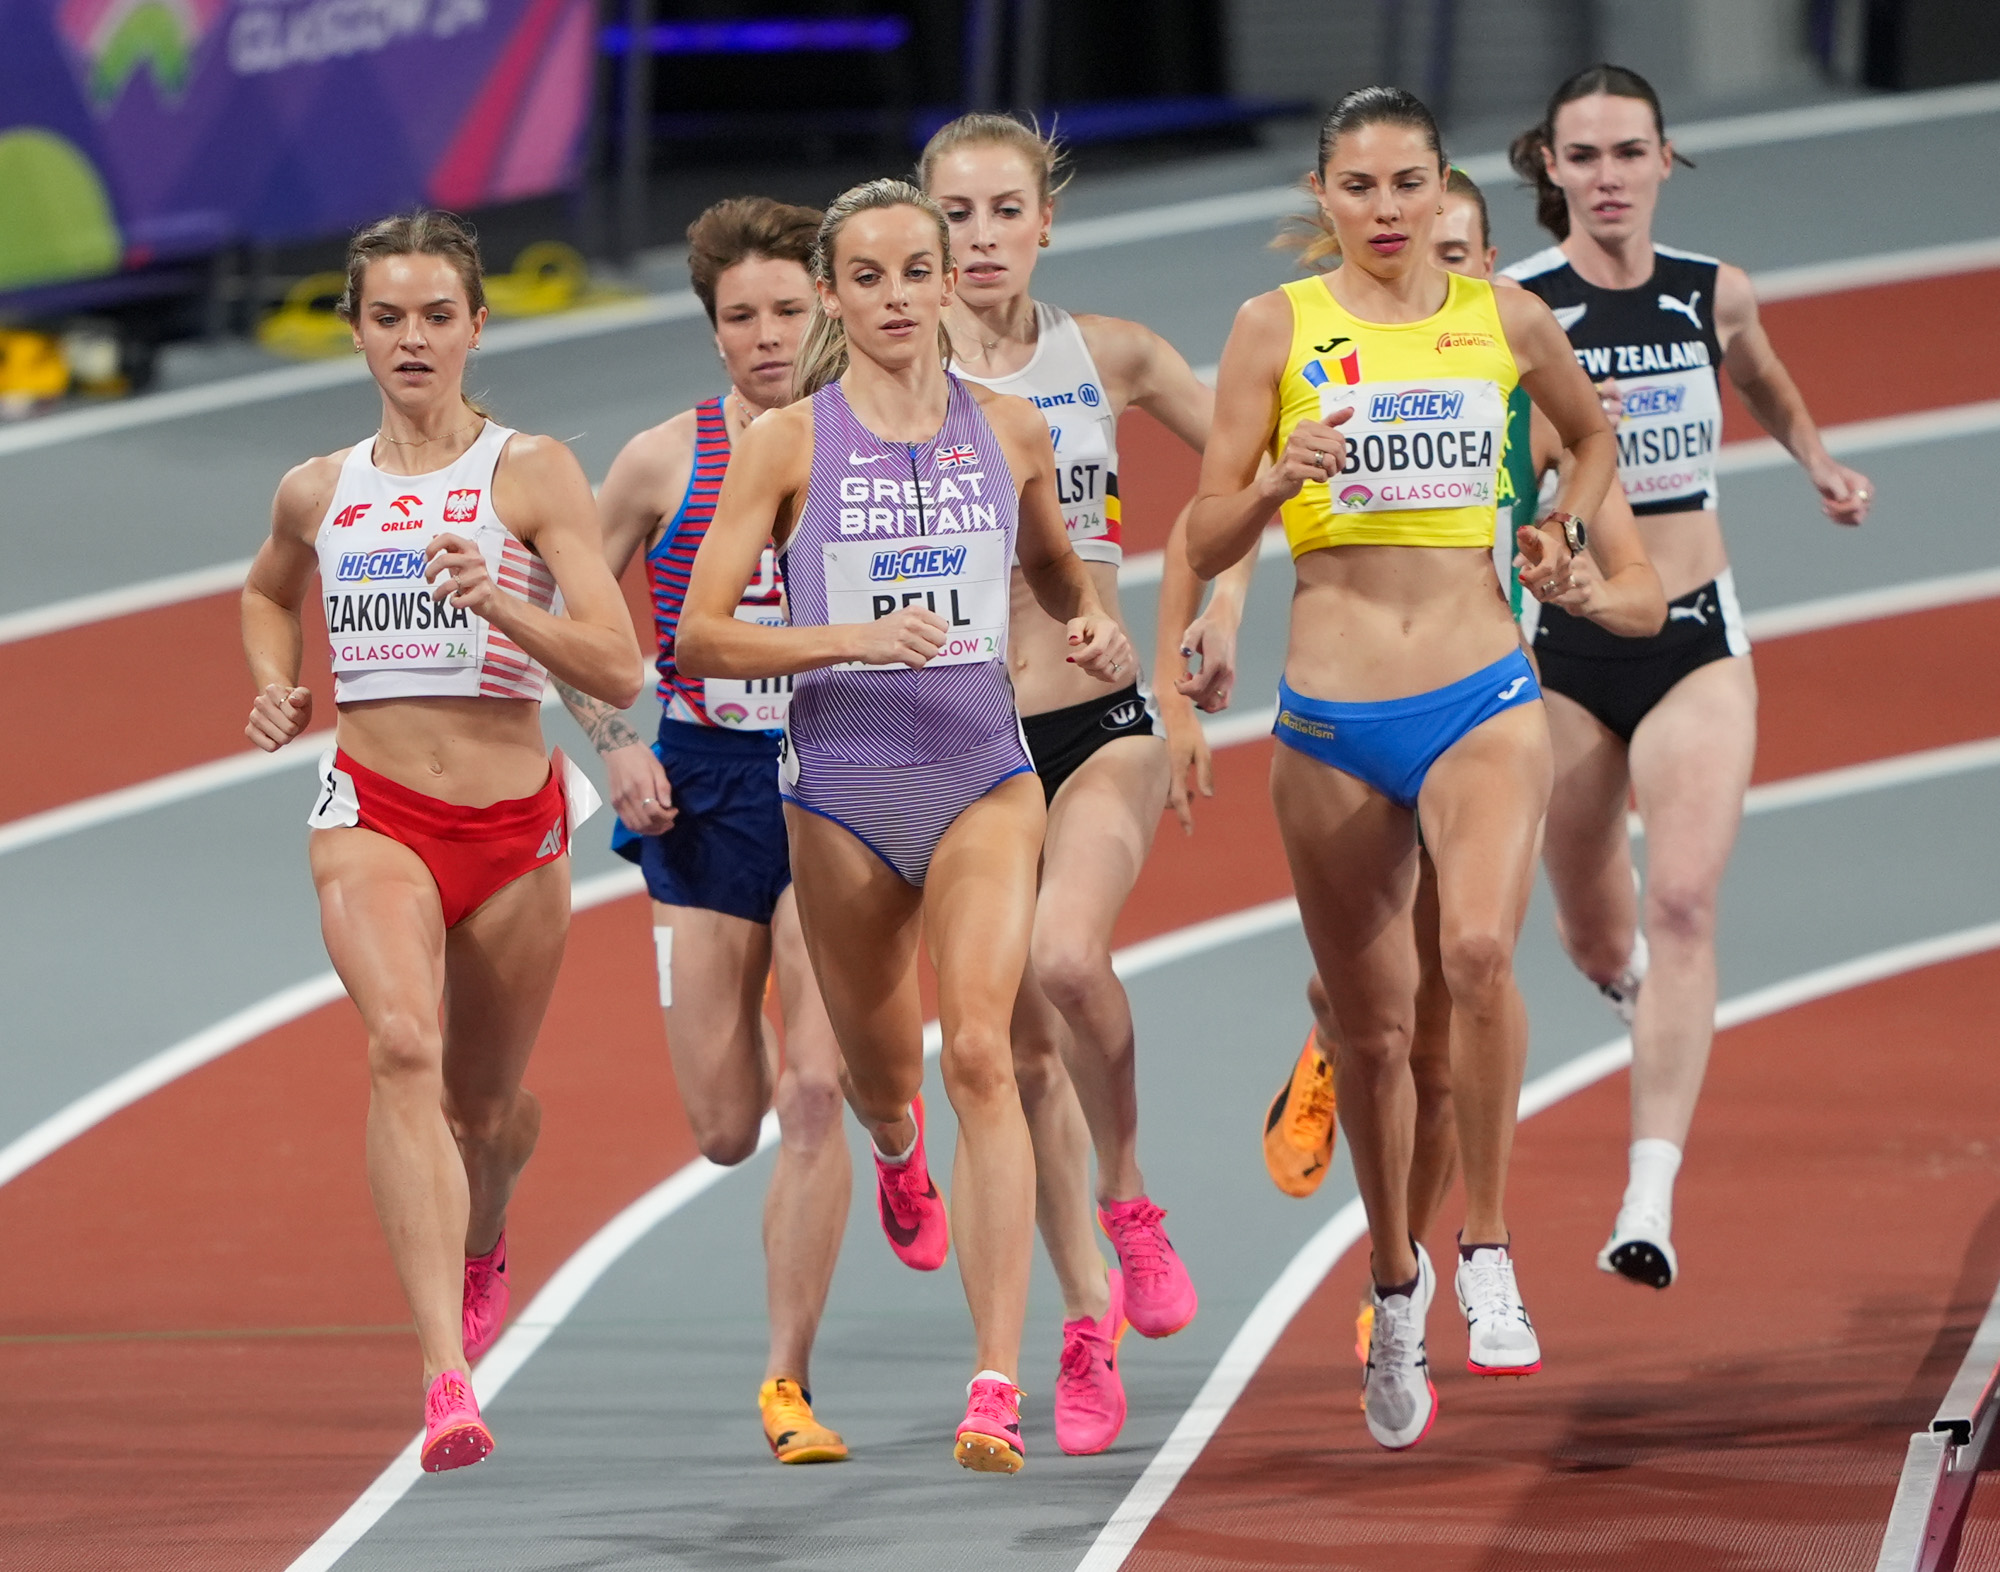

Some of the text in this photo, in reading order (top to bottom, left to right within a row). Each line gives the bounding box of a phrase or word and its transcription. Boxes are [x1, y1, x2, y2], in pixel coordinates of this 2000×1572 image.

[1614, 340, 1710, 373] ZEALAND
[1368, 389, 1464, 423] HI-CHEW
[1341, 430, 1492, 475] BOBOCEA
[1616, 418, 1713, 468] MSDEN
[840, 472, 984, 504] GREAT
[1380, 482, 1474, 502] GLASGOW
[381, 519, 424, 533] ORLEN
[840, 503, 998, 535] BRITAIN
[1082, 513, 1100, 529] 24
[869, 544, 967, 582] HI-CHEW
[326, 591, 468, 634] ZAKOWSKA
[341, 642, 468, 662] GLASGOW 24
